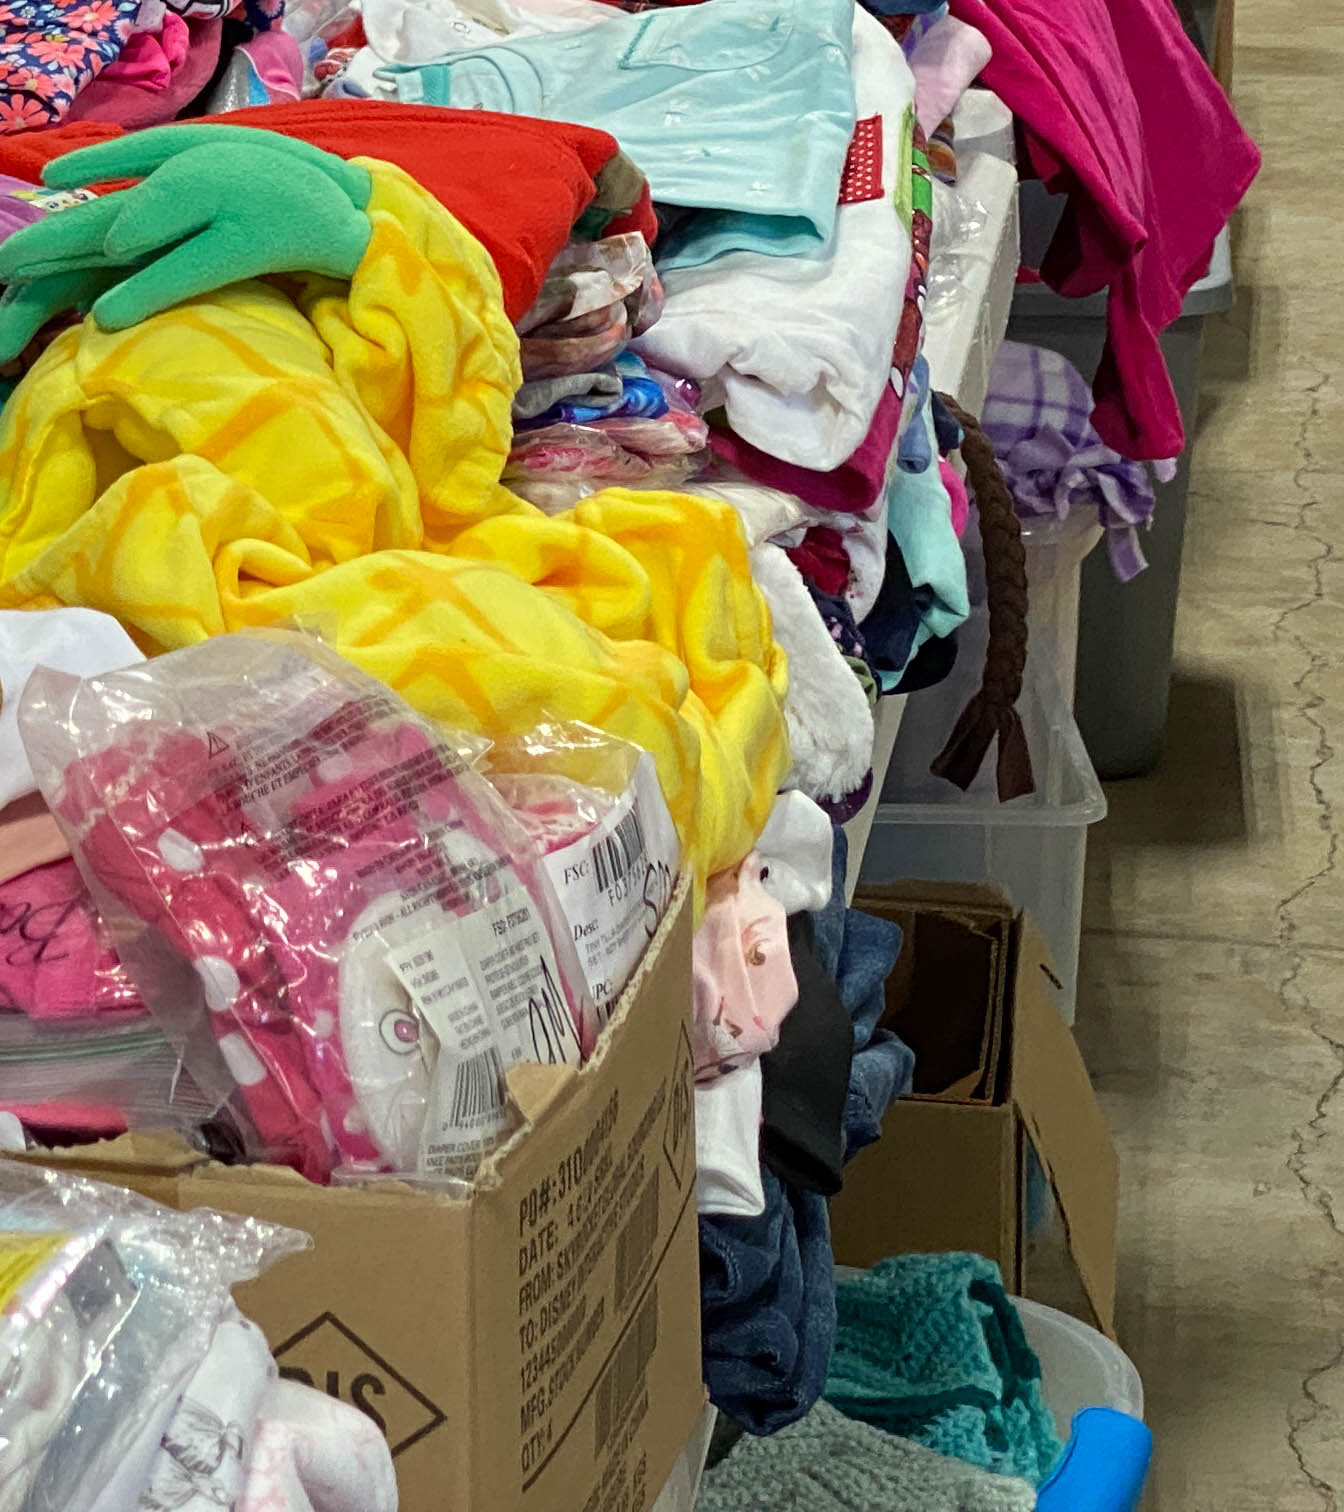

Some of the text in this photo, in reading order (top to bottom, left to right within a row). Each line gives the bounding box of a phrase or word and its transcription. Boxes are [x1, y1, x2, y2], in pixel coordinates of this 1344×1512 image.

[564, 859, 591, 885] FSC:
[519, 1218, 559, 1277] DATE:
[519, 1261, 556, 1317] FROM:
[519, 1318, 539, 1356] TO:
